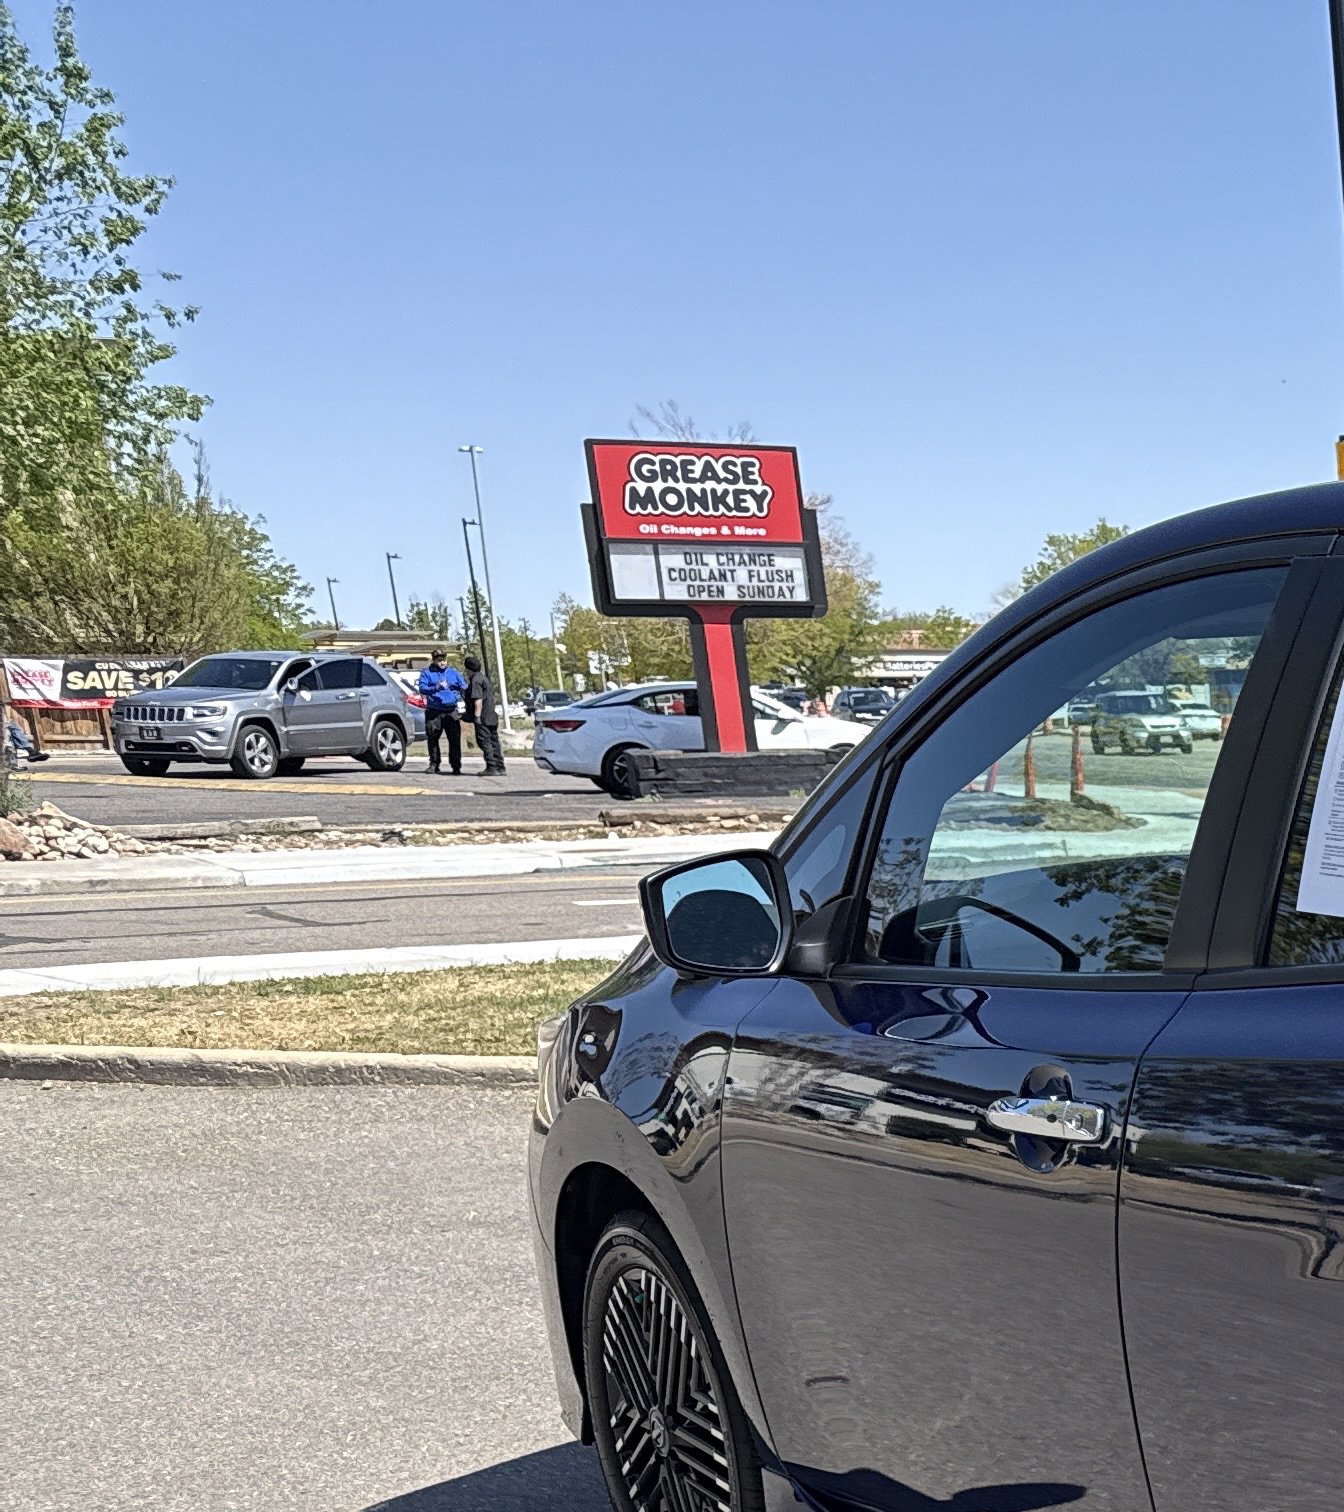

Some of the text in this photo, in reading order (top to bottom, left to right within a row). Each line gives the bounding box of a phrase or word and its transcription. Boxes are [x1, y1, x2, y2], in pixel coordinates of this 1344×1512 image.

[634, 457, 757, 486] GREASE
[629, 486, 768, 513] MONKEY
[639, 524, 767, 536] Oil Changes & More
[683, 552, 775, 567] OIL CHANGE
[668, 568, 795, 584] COOLANT FLUSH
[687, 584, 796, 600] OPEN SUNDAY
[66, 671, 134, 690] SAVE
